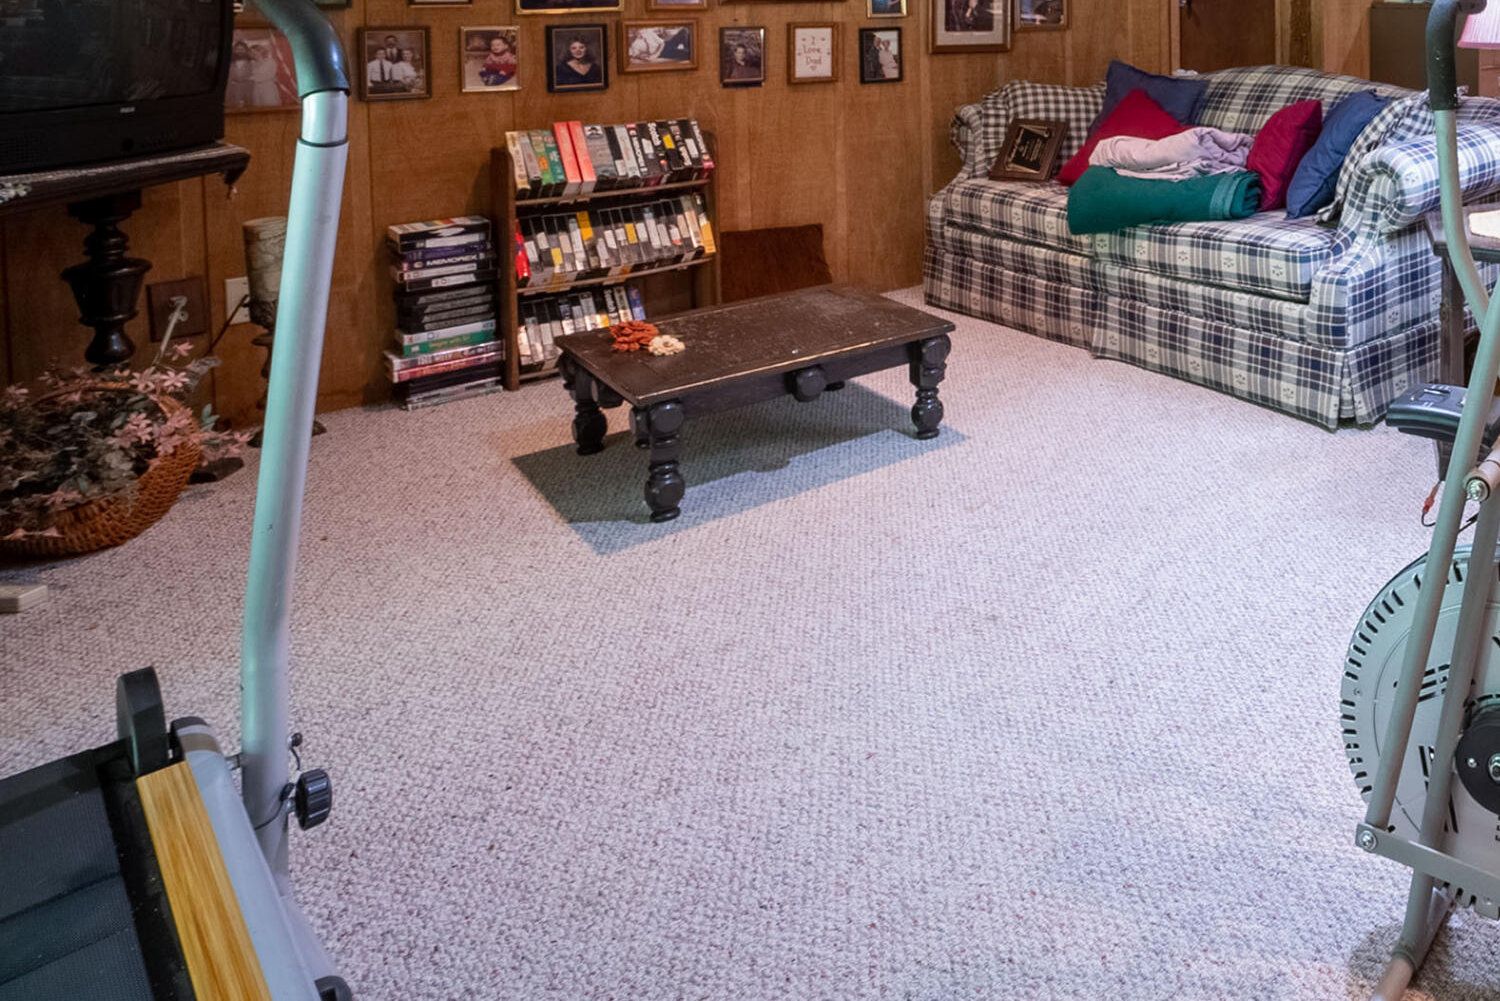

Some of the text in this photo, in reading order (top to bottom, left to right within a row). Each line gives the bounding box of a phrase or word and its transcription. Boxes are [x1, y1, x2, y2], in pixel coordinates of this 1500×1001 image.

[803, 44, 822, 55] Love
[806, 56, 822, 66] Dad
[426, 254, 478, 267] MEMOREX
